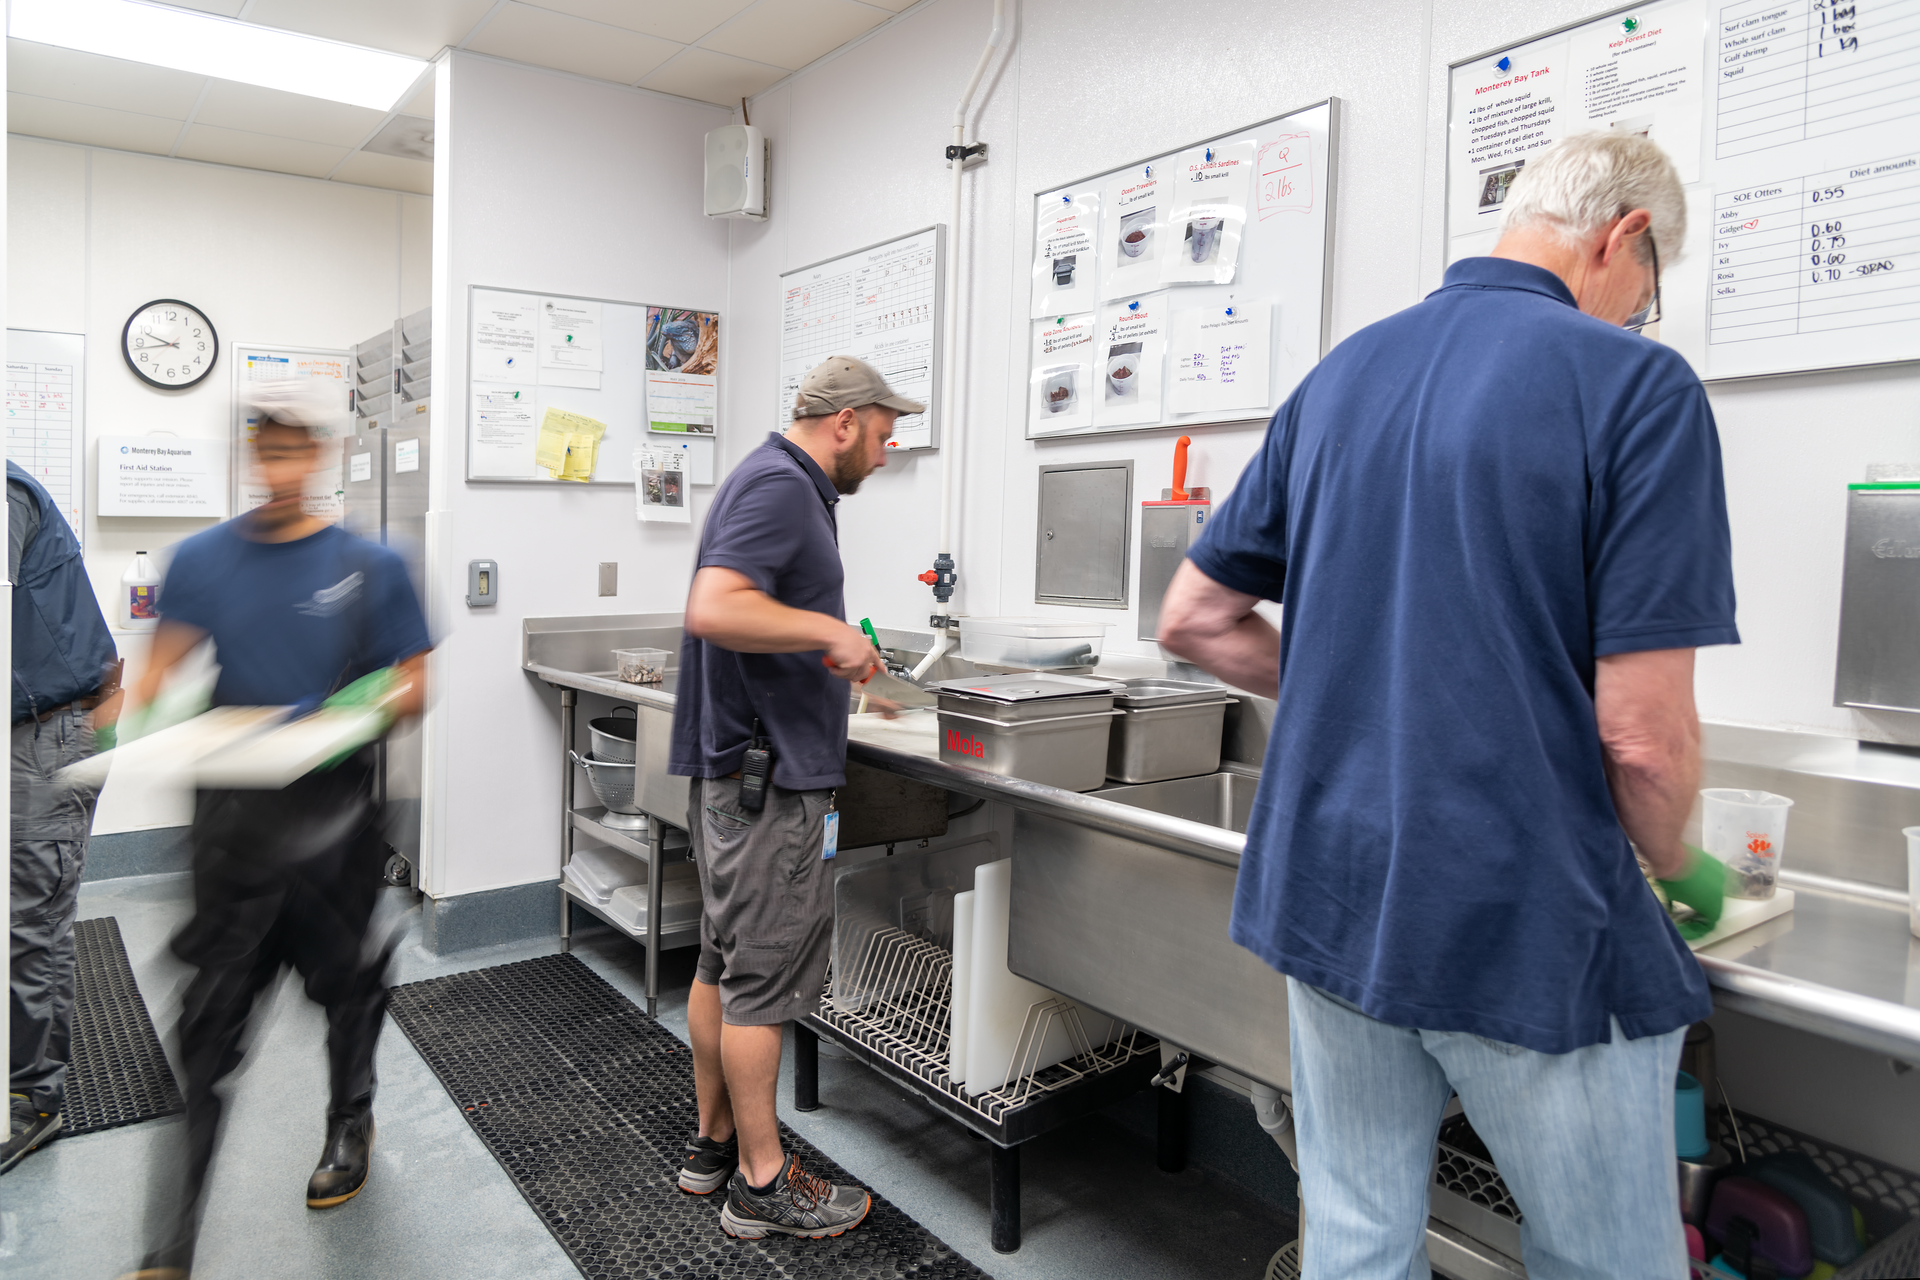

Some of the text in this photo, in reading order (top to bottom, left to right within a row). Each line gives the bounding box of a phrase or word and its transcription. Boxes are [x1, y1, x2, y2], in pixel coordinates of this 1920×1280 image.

[1725, 10, 1788, 33] Surf clam tongue
[1609, 28, 1662, 48] Kelp Forest Diet
[1725, 27, 1786, 48] Whole surf clam
[1633, 40, 1656, 51] container)
[1724, 46, 1768, 63] Gulf shrimp
[1723, 67, 1744, 78] Squid
[1475, 66, 1550, 95] Monterey Bay Tank
[1495, 98, 1513, 107] whole
[1515, 92, 1531, 102] squid
[1491, 109, 1513, 119] mixture
[1522, 102, 1537, 110] large
[1538, 96, 1552, 105] krill,
[1472, 122, 1496, 134] chopped
[1511, 111, 1536, 123] chopped
[1538, 105, 1554, 116] squid
[1480, 130, 1506, 141] Tuesdays
[1508, 125, 1518, 134] and
[1520, 118, 1551, 130] Thursdays
[1476, 142, 1503, 153] container
[1511, 135, 1521, 144] gel
[1471, 156, 1486, 164] Mon,
[1487, 151, 1503, 159] Wed,
[1514, 145, 1526, 153] Sat,
[1527, 141, 1539, 149] and
[1540, 138, 1552, 146] Sun
[1200, 162, 1217, 170] Exhibit
[1218, 160, 1239, 168] Sardines
[1849, 158, 1916, 178] Diet amounts
[1195, 171, 1203, 180] 10
[1121, 180, 1157, 195] Ocean Travelers
[1265, 181, 1275, 201] 2
[1733, 187, 1782, 203] SOE Otters
[1812, 186, 1844, 203] 0.55
[1720, 210, 1739, 220] Abby
[1719, 224, 1744, 235] Gidget
[1811, 221, 1842, 237] 0.60
[1718, 241, 1730, 250] Ivy
[1717, 271, 1735, 280] Rosa
[1717, 287, 1735, 295] Selka
[152, 314, 160, 324] 11
[165, 311, 177, 321] 12
[184, 317, 188, 326] 1
[140, 324, 152, 335] 10
[193, 328, 201, 338] 2
[136, 337, 144, 348] 9
[197, 341, 205, 351] 3
[140, 352, 149, 362] 8
[193, 355, 201, 365] 4
[152, 363, 159, 373] 7
[167, 368, 175, 378] 6
[182, 365, 190, 375] 5
[131, 447, 191, 456] Monterey Bay Aquarium
[947, 729, 984, 758] Mola
